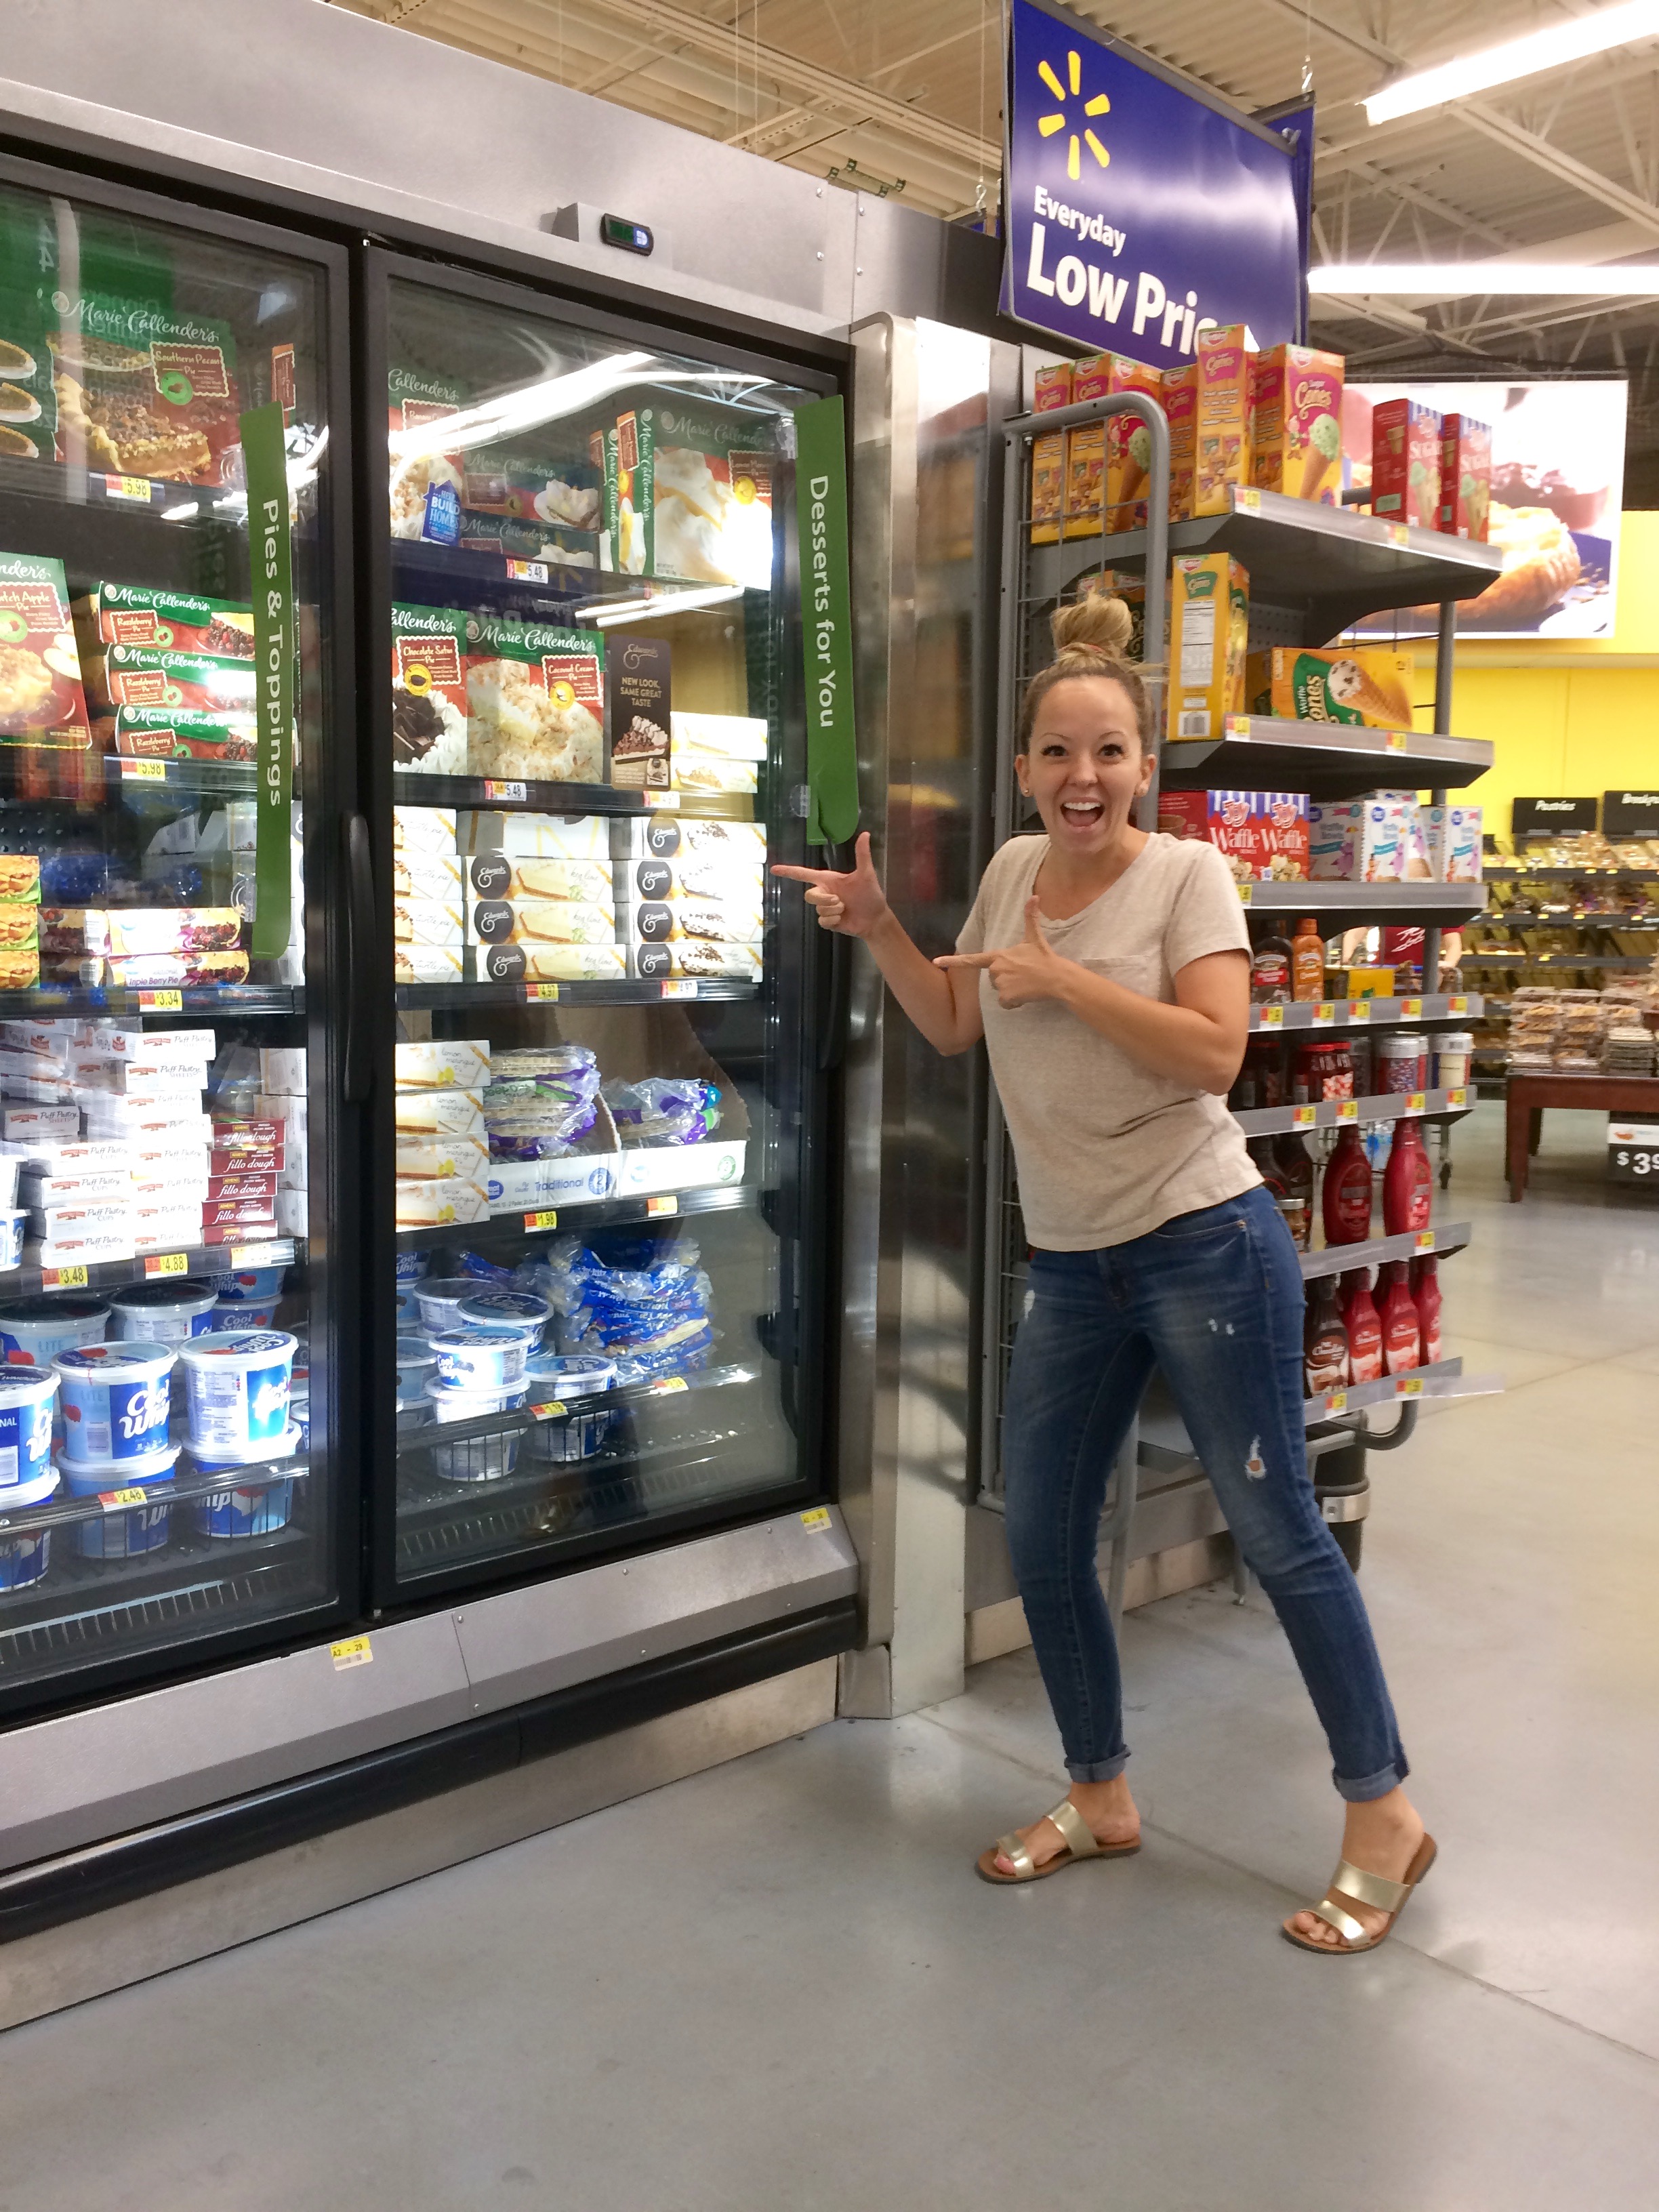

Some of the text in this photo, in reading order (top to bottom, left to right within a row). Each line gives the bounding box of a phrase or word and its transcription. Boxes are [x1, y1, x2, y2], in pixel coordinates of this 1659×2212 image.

[1033, 184, 1126, 257] Everyday
[1027, 222, 1218, 356] Low Pric
[65, 299, 123, 327] Marie
[123, 306, 219, 343] Callender's
[155, 351, 220, 365] Southern Pecan
[388, 369, 459, 401] Callender's
[639, 417, 652, 455] Marie
[672, 415, 712, 440] Marie
[468, 453, 502, 471] Marie
[431, 496, 460, 515] BUILD
[464, 518, 499, 535] Marie
[499, 522, 550, 542] Callender's
[22, 590, 50, 605] Apple
[115, 588, 210, 611] Marie Callender's
[810, 476, 835, 729] Desserts for You
[476, 624, 596, 652] Marie Callender's
[123, 649, 218, 670] Marie Callender's
[263, 499, 283, 807] Pies & Toppings
[403, 646, 434, 656] Chocolate
[621, 676, 638, 686] NEW
[620, 687, 662, 699] SAME GREAT
[1303, 675, 1326, 722] ones
[632, 698, 651, 707] TASTE
[134, 709, 168, 726] Marie
[1210, 827, 1261, 851] Waffle
[1261, 829, 1308, 852] Waffle
[178, 1065, 202, 1073] Pastry
[57, 1111, 79, 1119] Pastry
[224, 1157, 275, 1172] fillo dough
[216, 1182, 268, 1198] fillo dough
[535, 1178, 584, 1191] Traditional
[105, 1207, 127, 1216] Pastry
[211, 1210, 234, 1225] fillo
[224, 1313, 253, 1326] Cool
[38, 1340, 64, 1353] LITE
[127, 1378, 169, 1416] Cool
